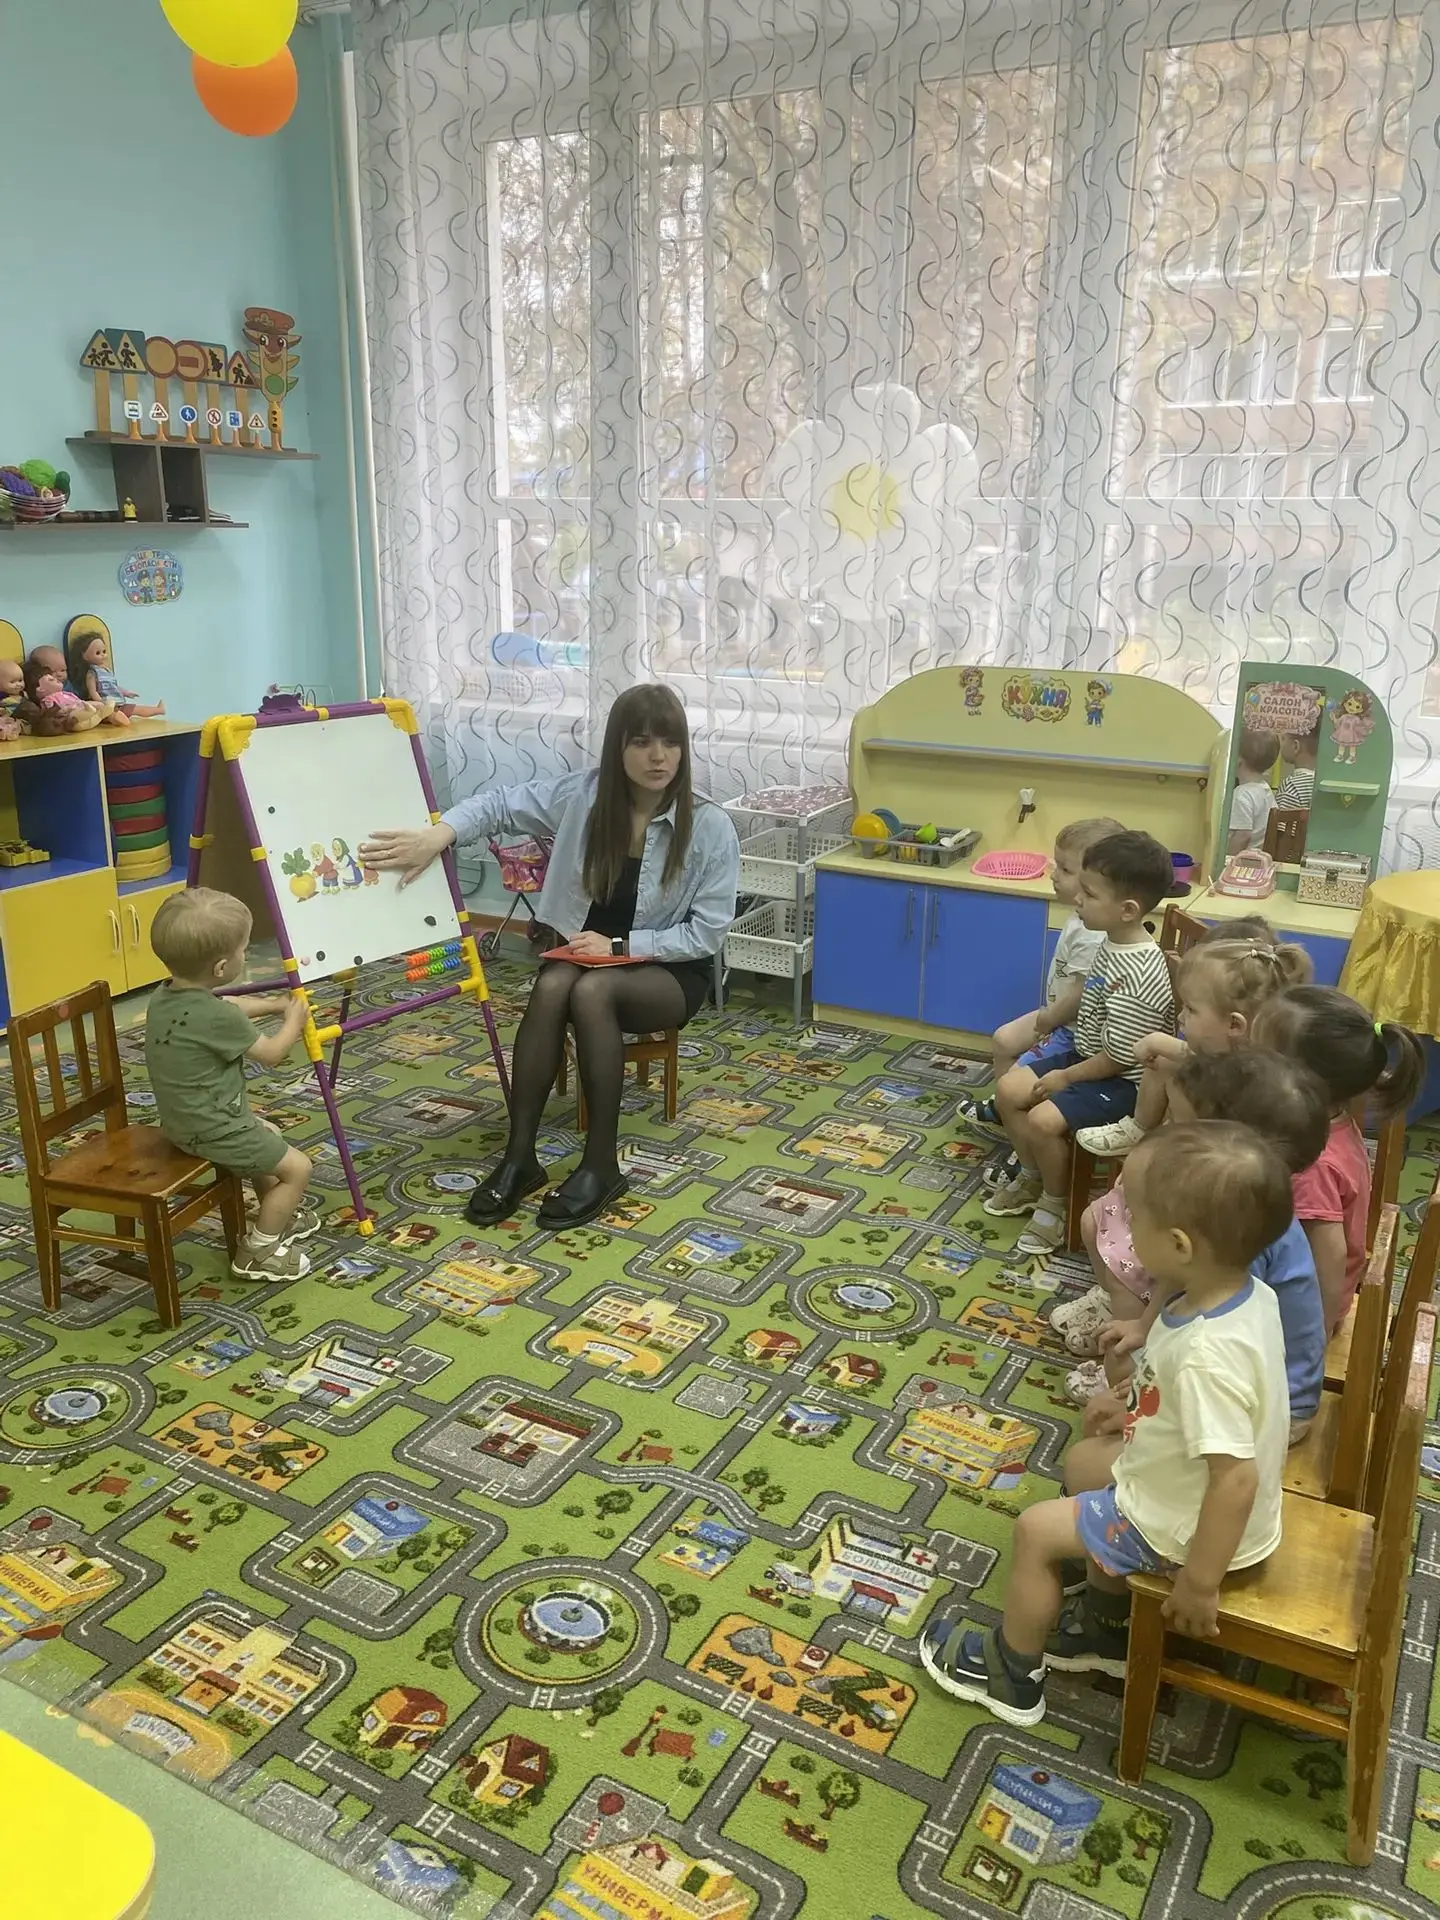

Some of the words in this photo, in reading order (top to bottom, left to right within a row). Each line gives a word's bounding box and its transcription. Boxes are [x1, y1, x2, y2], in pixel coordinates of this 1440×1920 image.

[1007, 679, 1068, 709] КУХНЯ
[1264, 696, 1302, 708] САЛОН
[1260, 705, 1306, 718] КРАСОТЫ
[842, 1549, 928, 1588] БОЛЬНИЦА
[582, 1863, 673, 1920] УНИВЕРМ
